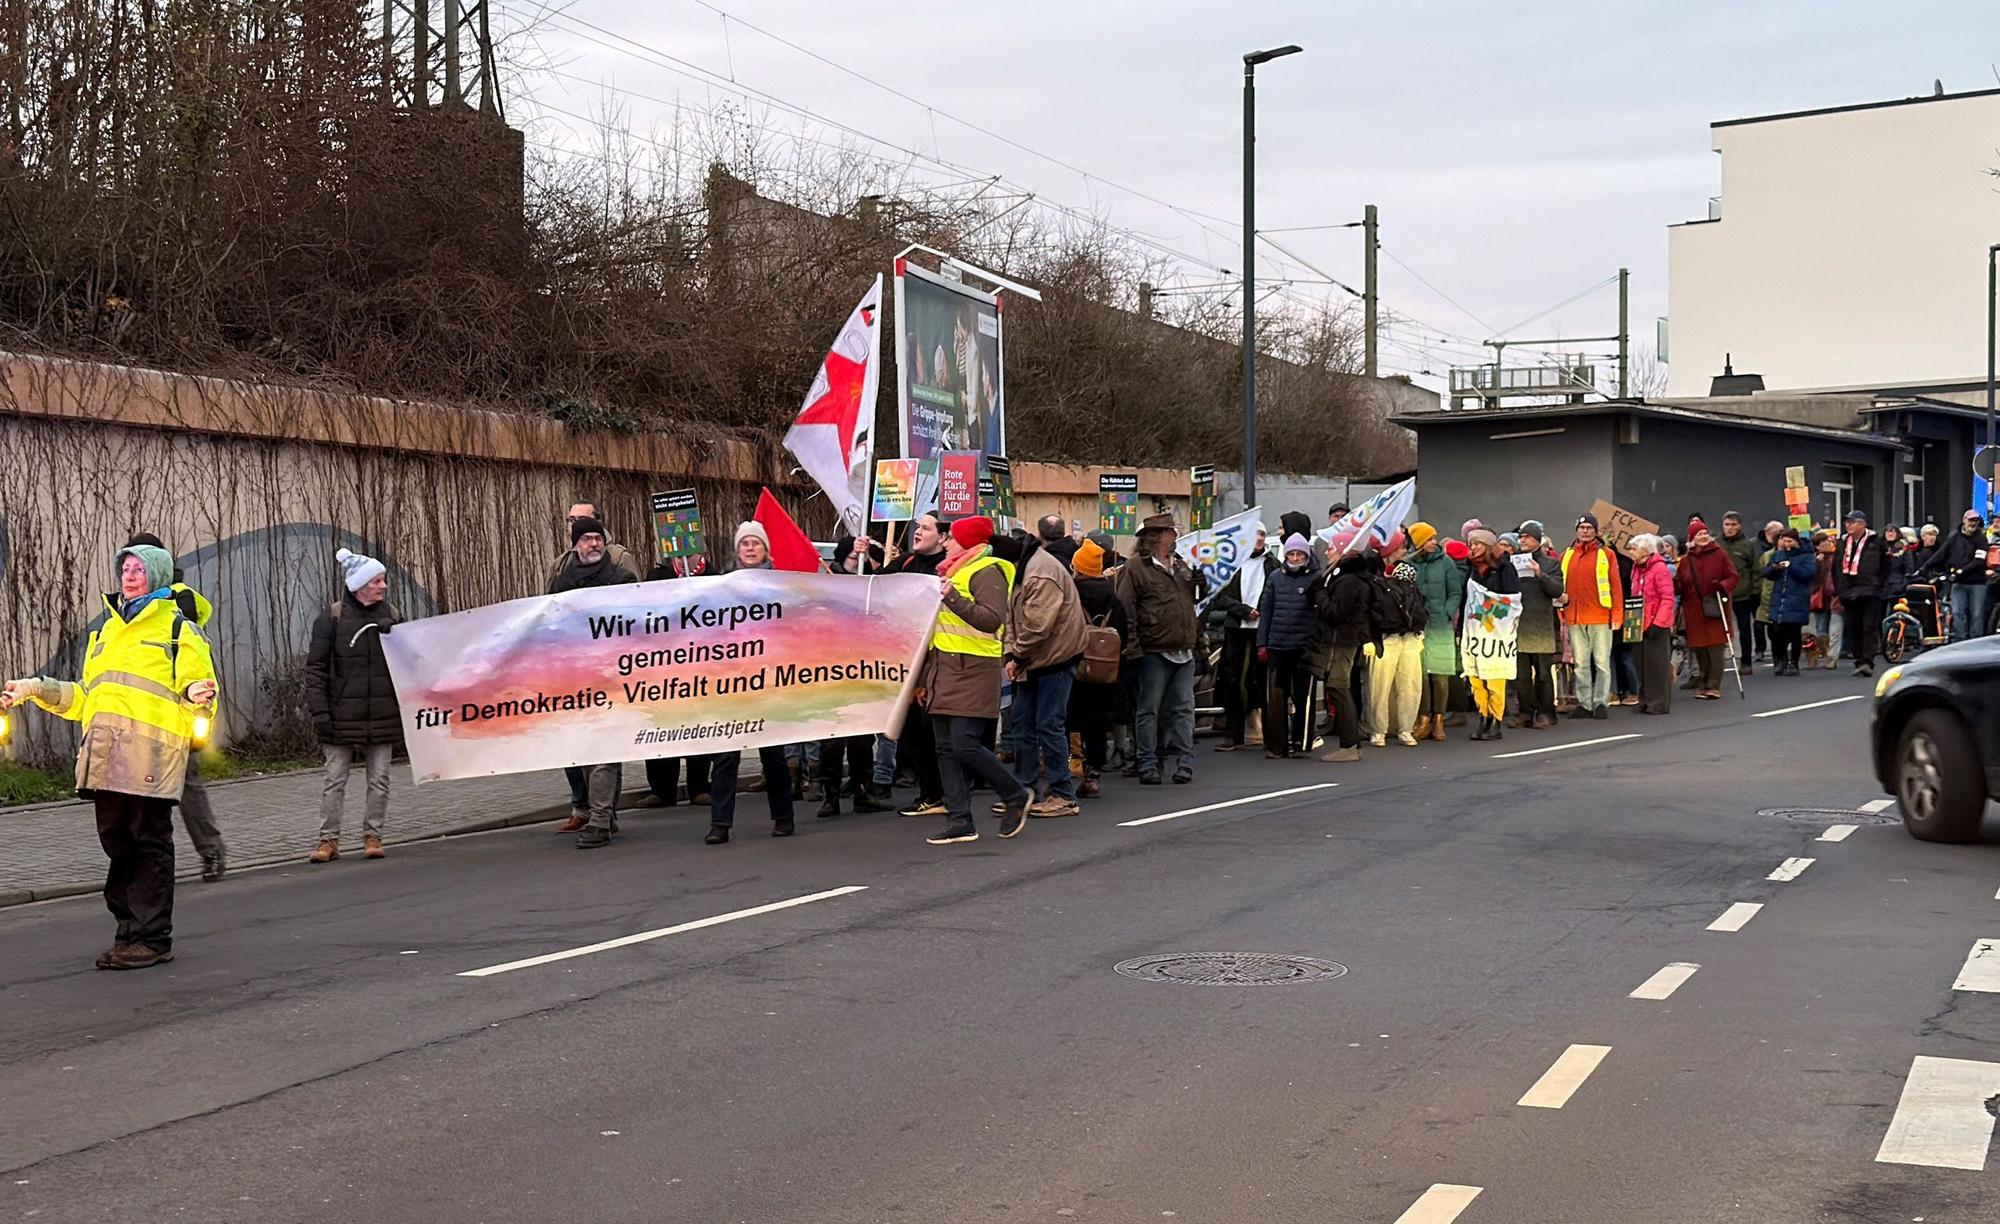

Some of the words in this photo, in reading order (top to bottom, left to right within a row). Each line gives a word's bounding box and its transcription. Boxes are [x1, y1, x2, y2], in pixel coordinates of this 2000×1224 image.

[944, 469, 963, 479] Rote
[944, 480, 967, 490] Karte
[944, 490, 957, 500] für
[957, 491, 970, 500] die
[944, 501, 962, 511] AfD!
[1611, 510, 1637, 529] FCK
[588, 614, 636, 639] Wir
[645, 611, 669, 634] in
[681, 602, 782, 630] Kerpen
[618, 639, 764, 676] gemeinsam
[415, 707, 453, 729] für
[461, 687, 613, 721] Demokratie,
[623, 675, 708, 703] Vielfalt
[716, 668, 765, 695] und
[634, 718, 765, 744] #niewiederistjetzt
